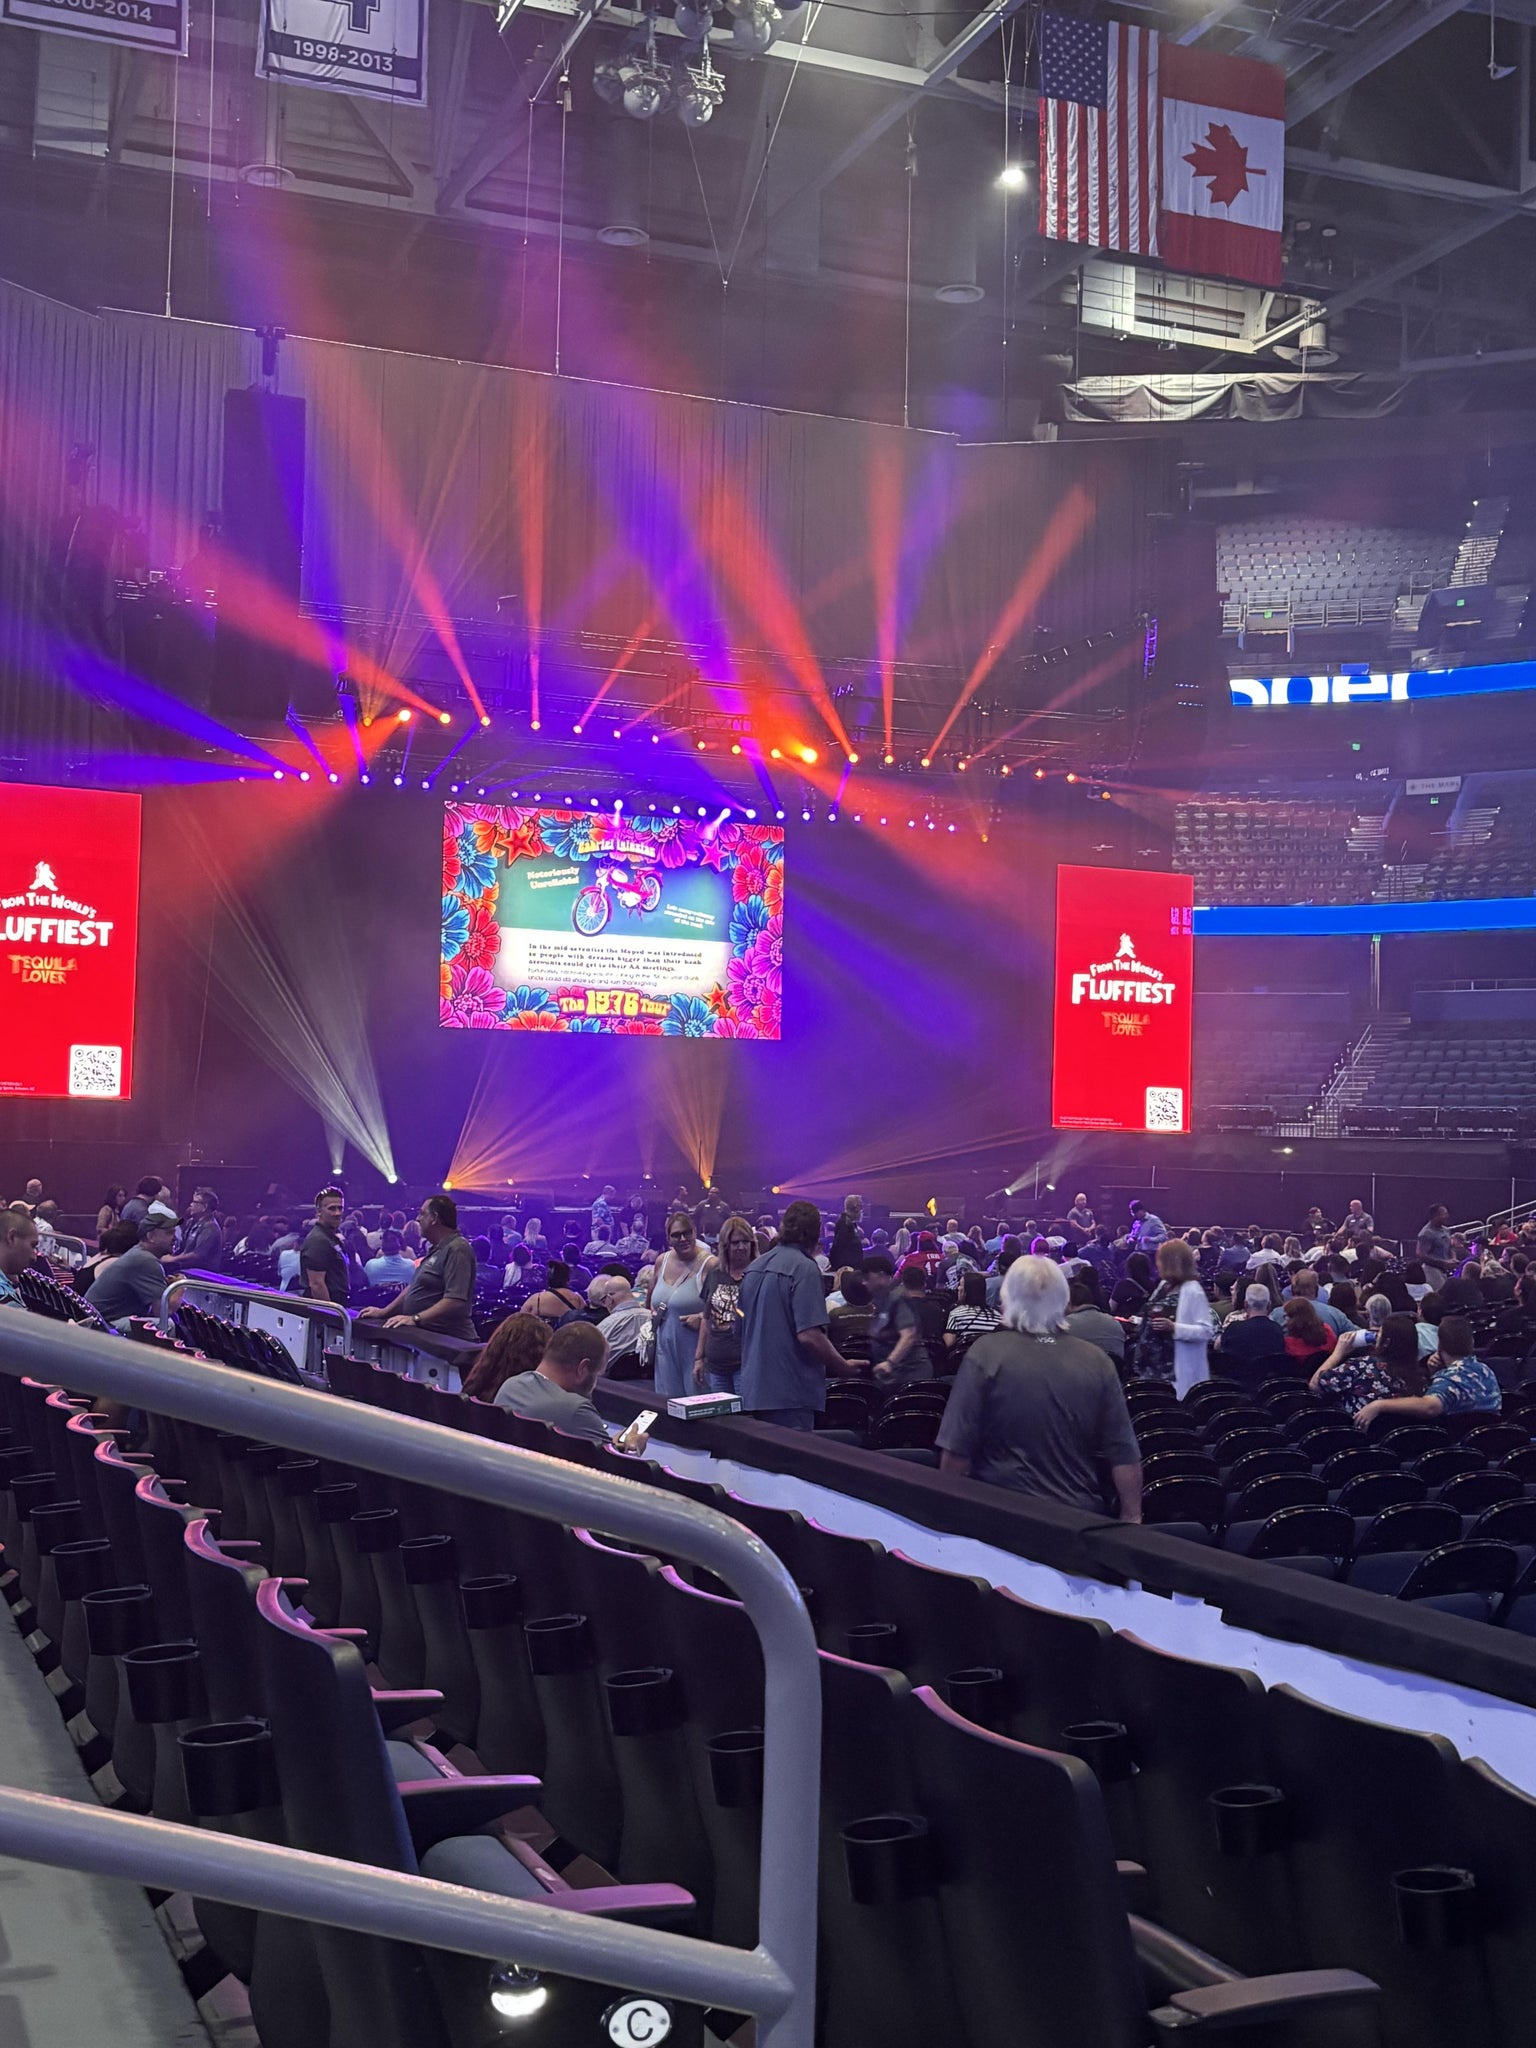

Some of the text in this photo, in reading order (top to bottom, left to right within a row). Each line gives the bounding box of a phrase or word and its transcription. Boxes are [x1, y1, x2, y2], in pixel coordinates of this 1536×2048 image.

[293, 40, 393, 72] 1998-2013
[0, 892, 97, 919] ROM THE WORLD'S
[8, 954, 78, 974] TEQUILA
[1089, 962, 1114, 977] FROM
[1113, 959, 1131, 971] THE
[1071, 973, 1176, 1005] FLUFFIEST
[559, 990, 672, 1017] The 1976 Tour
[1101, 1011, 1151, 1028] TEQUILA
[626, 2006, 654, 2041] C
